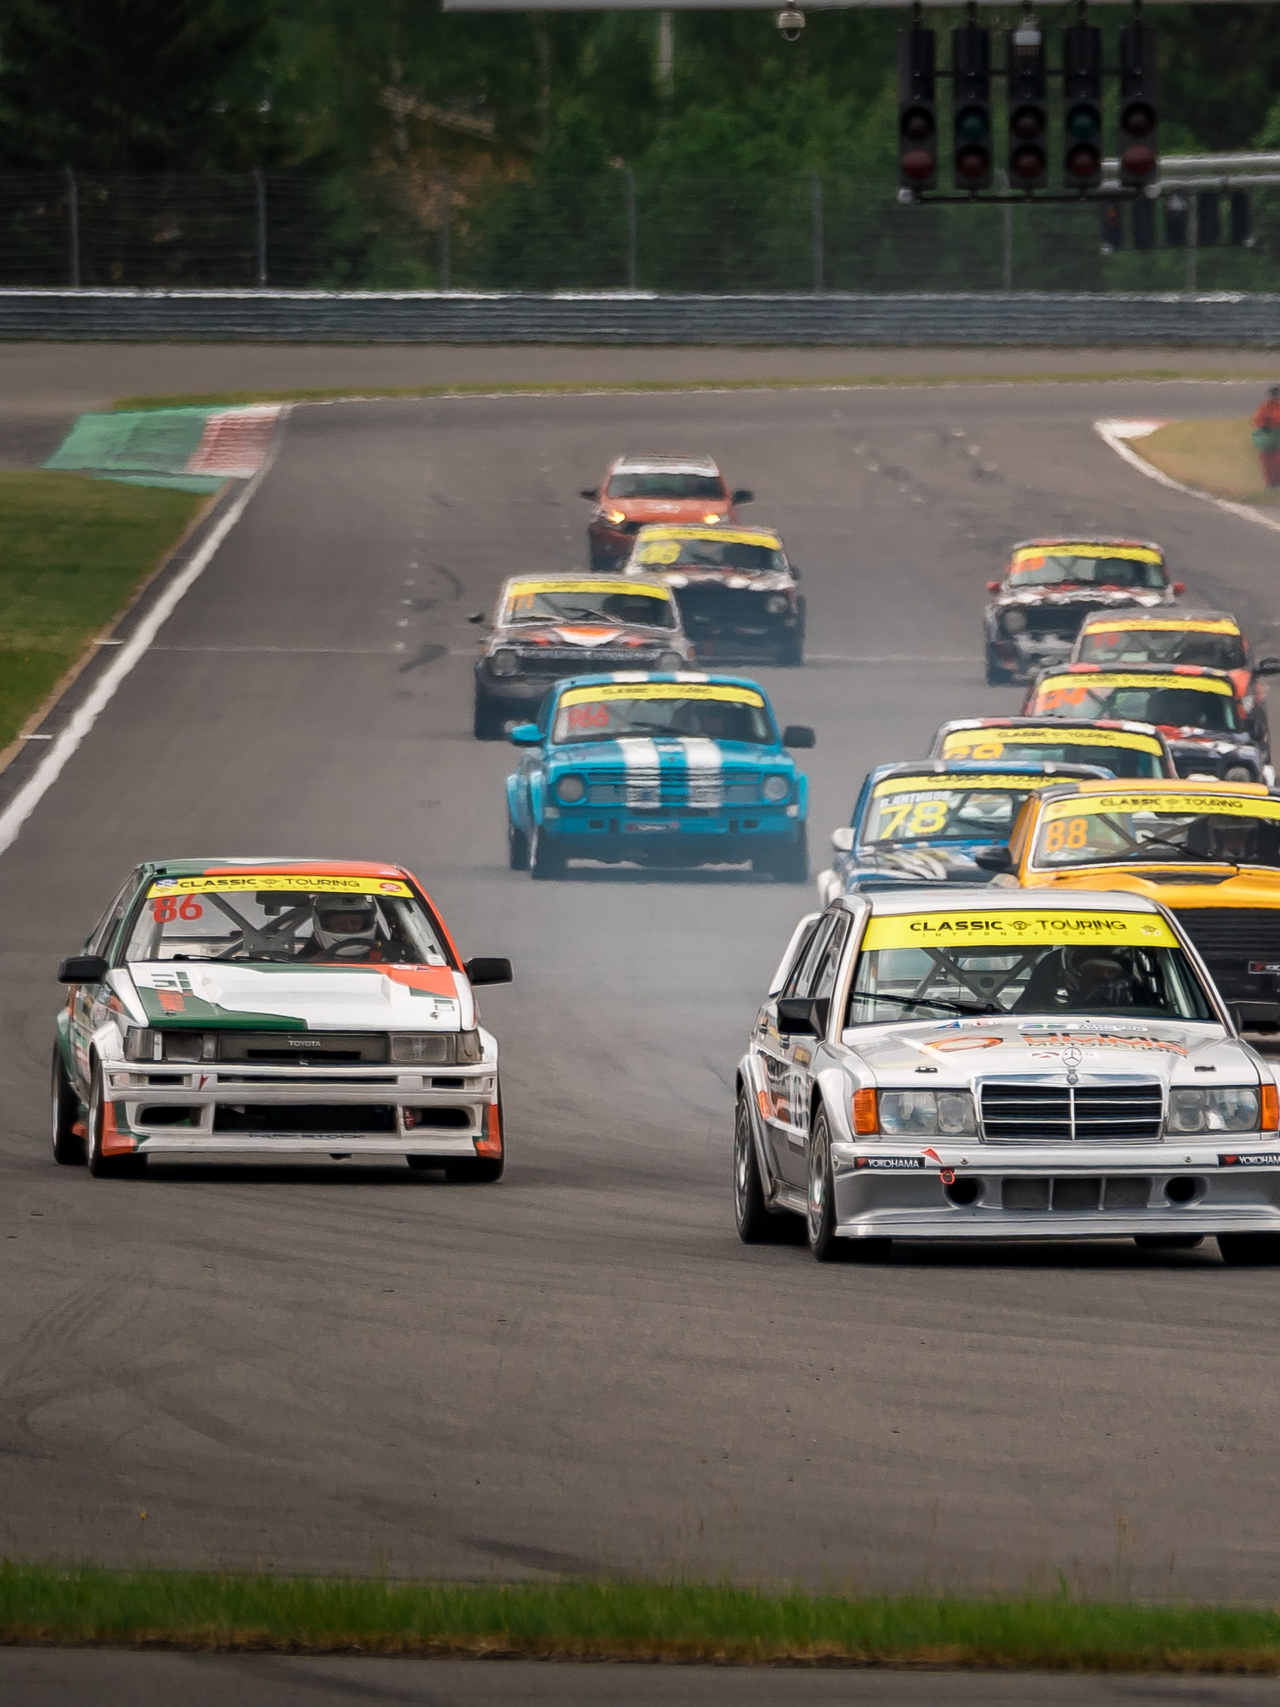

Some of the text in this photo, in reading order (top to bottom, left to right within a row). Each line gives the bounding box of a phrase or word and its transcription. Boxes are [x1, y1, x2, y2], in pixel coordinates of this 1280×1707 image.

[569, 704, 610, 730] 966
[1100, 797, 1244, 808] CLASSIC TOURING
[880, 801, 949, 840] 78
[1045, 818, 1088, 851] 88
[179, 878, 258, 889] CLASSIC
[287, 878, 361, 888] TOURING
[153, 893, 204, 923] 86
[909, 919, 1128, 931] CLASSIC TOURING
[288, 1039, 322, 1047] TOYOTA
[867, 1158, 920, 1168] YOKOHAMA
